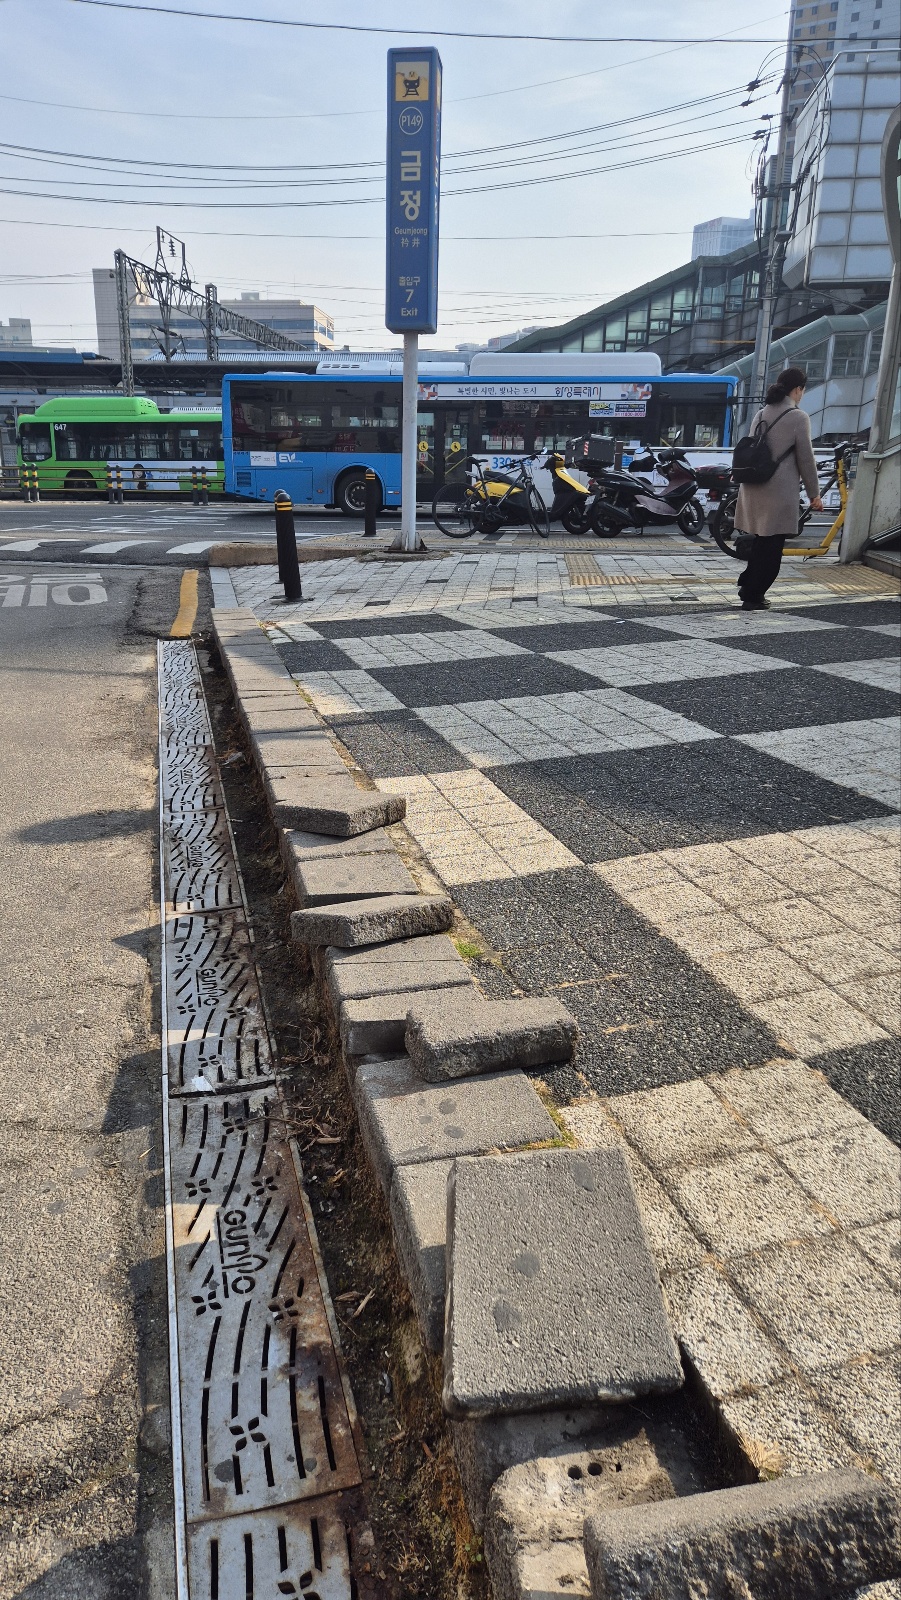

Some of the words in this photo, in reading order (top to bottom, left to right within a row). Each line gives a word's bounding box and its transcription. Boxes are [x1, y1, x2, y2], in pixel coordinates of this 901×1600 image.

[401, 114, 421, 127] P149
[400, 150, 421, 221] 금정
[394, 226, 428, 236] Geumjeong
[398, 276, 421, 287] 출입구
[405, 289, 415, 303] 7
[401, 307, 419, 317] Exit
[523, 386, 538, 396] 도시
[54, 423, 67, 431] 647
